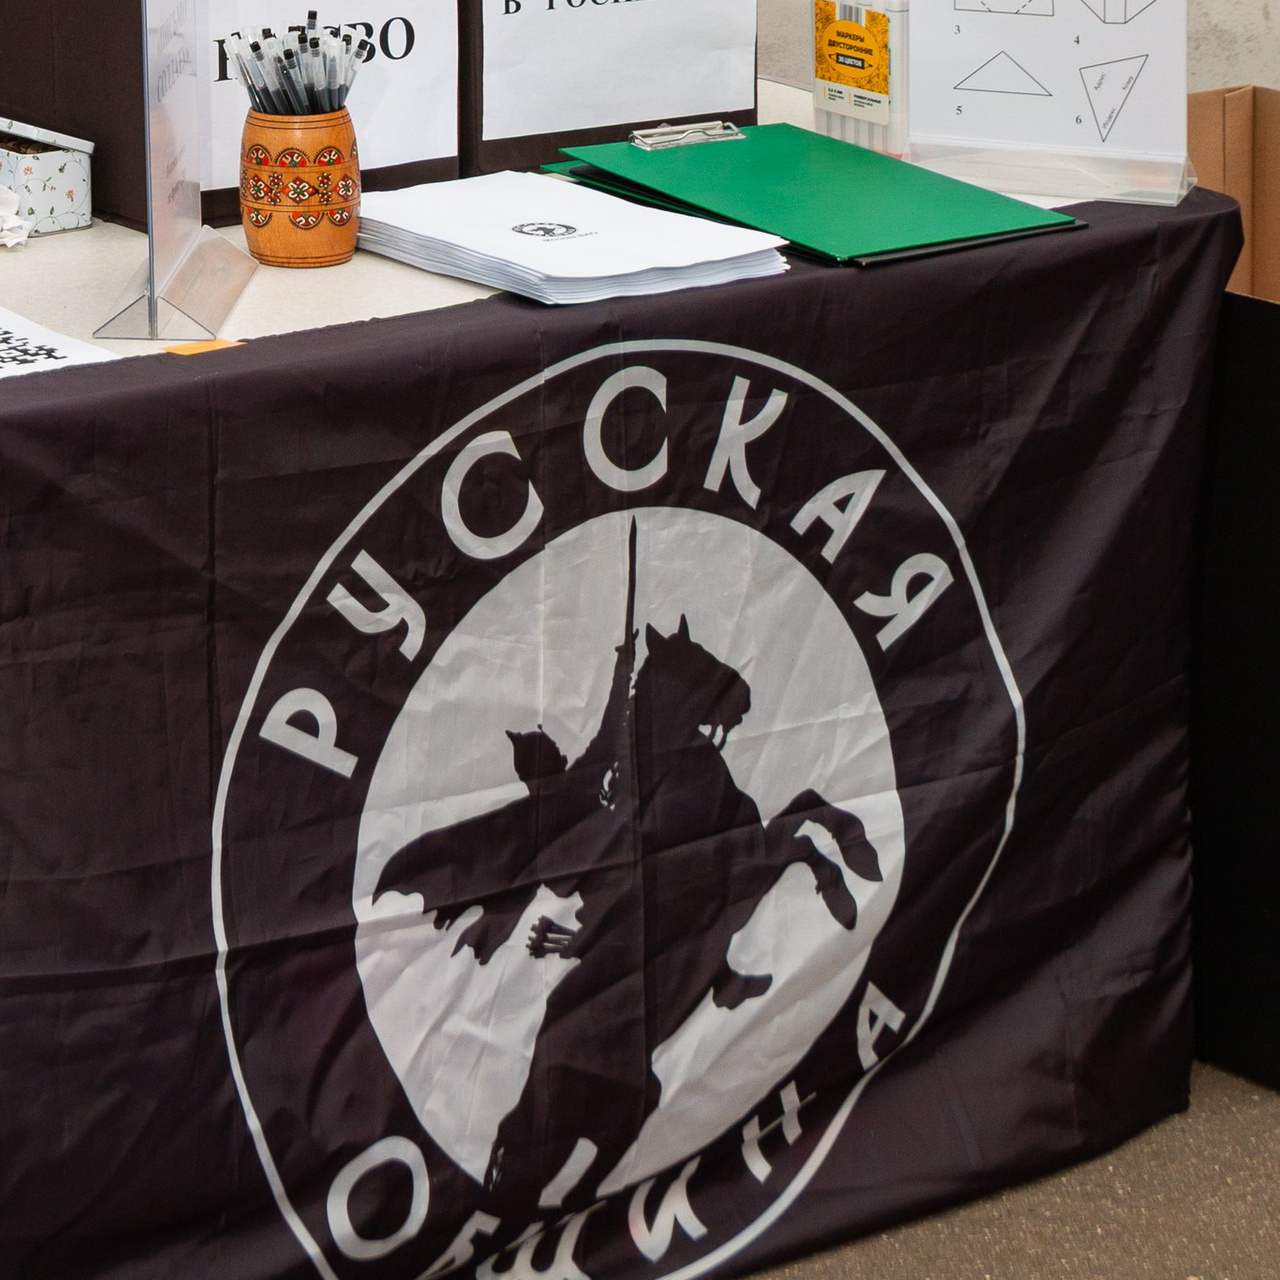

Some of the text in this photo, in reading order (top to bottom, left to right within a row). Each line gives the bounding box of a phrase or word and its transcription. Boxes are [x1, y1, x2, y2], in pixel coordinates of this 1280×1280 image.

[954, 25, 961, 34] 3
[836, 30, 865, 42] МАРКЕРЫ
[1073, 36, 1080, 45] 4
[828, 39, 873, 56] ДВУСТОРОННИЕ
[956, 106, 963, 115] 5
[1075, 115, 1082, 124] 6
[258, 365, 955, 781] РУССКАЯ
